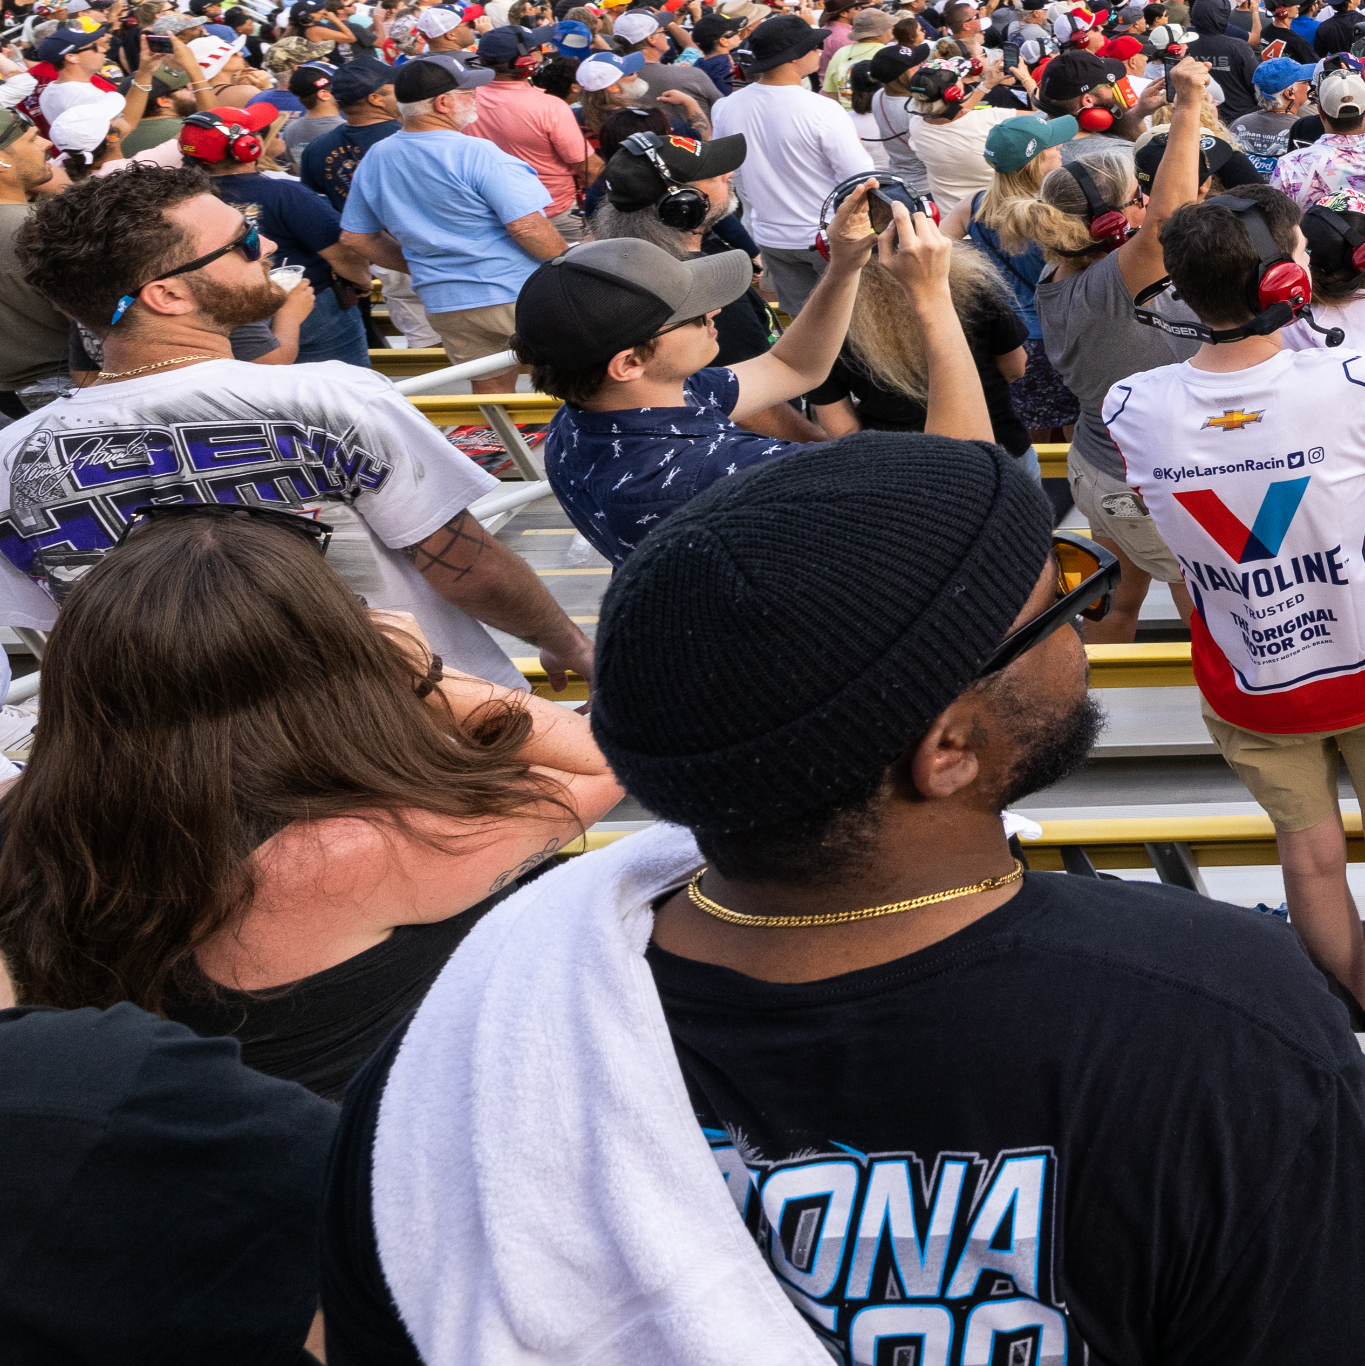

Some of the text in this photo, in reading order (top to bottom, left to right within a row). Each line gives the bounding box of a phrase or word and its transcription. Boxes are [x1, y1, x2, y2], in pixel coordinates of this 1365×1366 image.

[1152, 316, 1197, 336] RUGGED
[1153, 457, 1284, 482] @KyleLarsonRacin
[1178, 544, 1349, 600] VALVOLINE
[1243, 594, 1304, 620] TRUSTED
[1252, 609, 1338, 643] ORIGINAL
[1300, 624, 1331, 641] OIL
